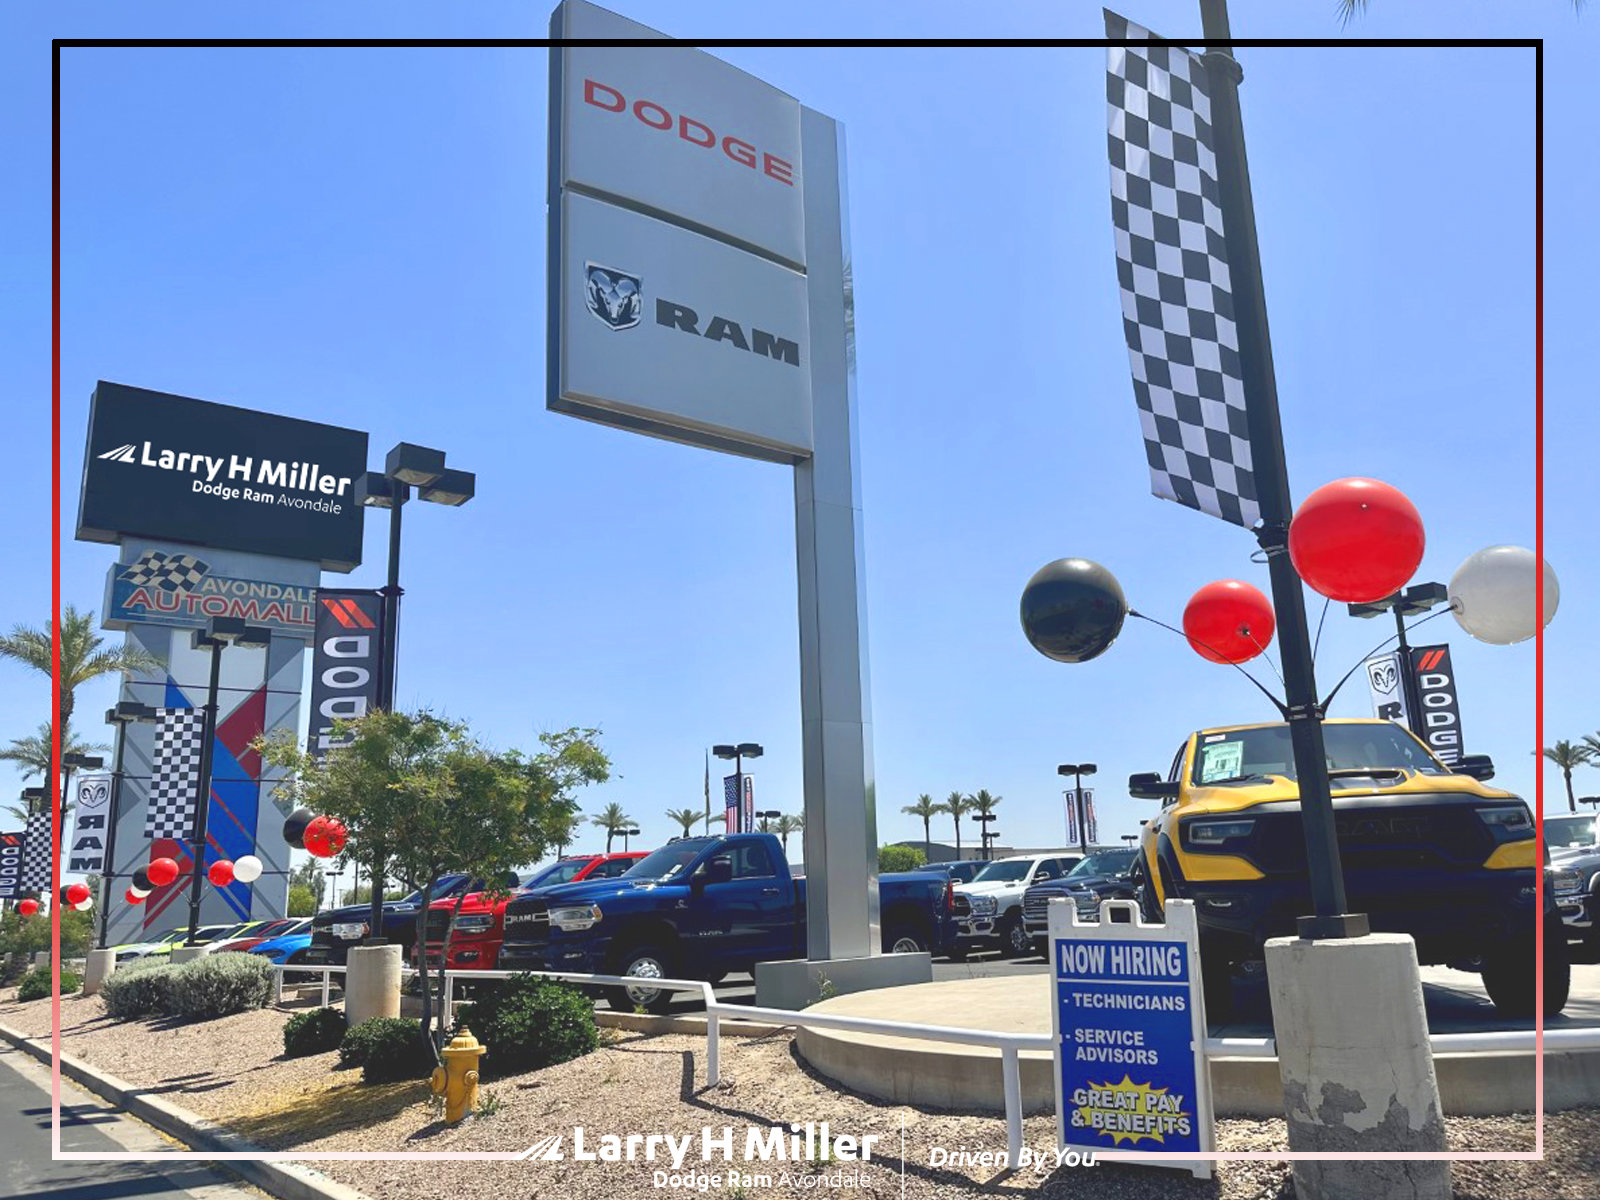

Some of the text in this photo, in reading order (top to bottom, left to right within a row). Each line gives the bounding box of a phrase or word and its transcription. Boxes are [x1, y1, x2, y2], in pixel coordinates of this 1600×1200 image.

[584, 79, 794, 186] DODGE
[656, 298, 800, 367] RAM
[141, 441, 351, 496] Larry H Miller
[192, 480, 342, 515] Dodge Ram Avondale
[122, 587, 316, 625] AUTOMALL
[1061, 944, 1182, 977] NOW HIRING
[1072, 992, 1186, 1011] TECHNICIANS
[1074, 1028, 1144, 1046] SERVICE
[1075, 1046, 1159, 1066] ADVISORS
[1073, 1088, 1184, 1114] GREAT PAY
[1071, 1109, 1191, 1136] & BENEFITS
